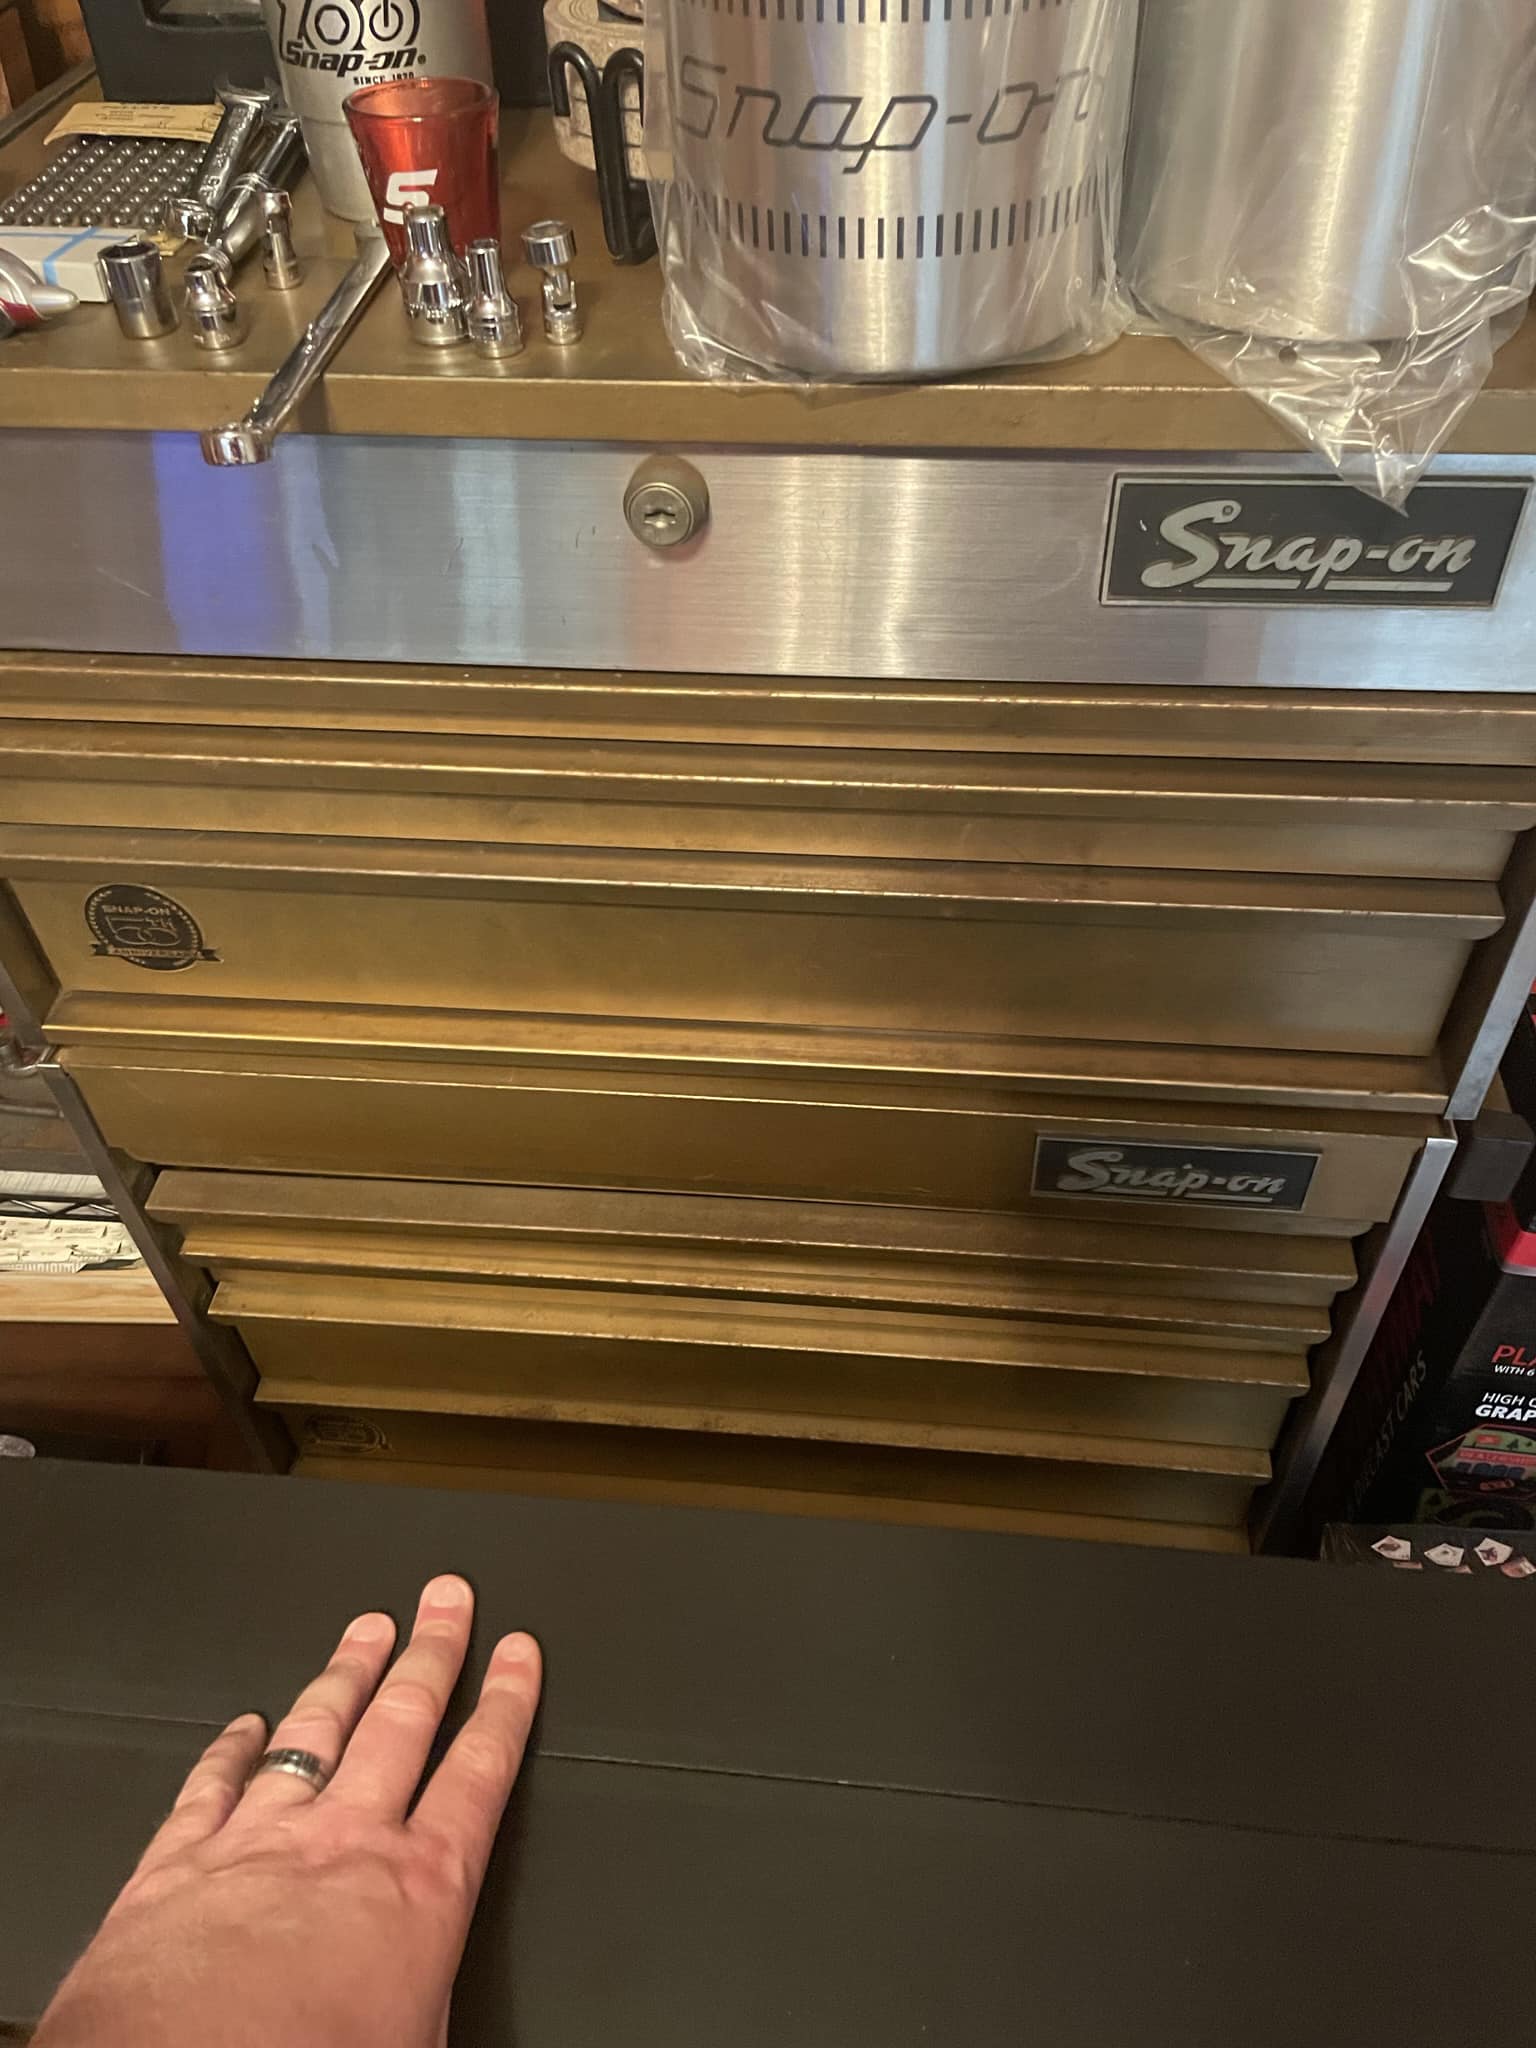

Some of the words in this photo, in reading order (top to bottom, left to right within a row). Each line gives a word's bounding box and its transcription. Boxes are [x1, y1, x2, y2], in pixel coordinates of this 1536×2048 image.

[353, 75, 385, 86] SINCE
[676, 55, 1089, 174] Snap-on
[1141, 499, 1477, 591] Snap-on
[1056, 1151, 1287, 1198] Snap-on
[1396, 1349, 1426, 1421] CARS
[1494, 1364, 1526, 1376] WITH
[1475, 1404, 1536, 1422] GRAP
[1482, 1392, 1526, 1407] HIGH
